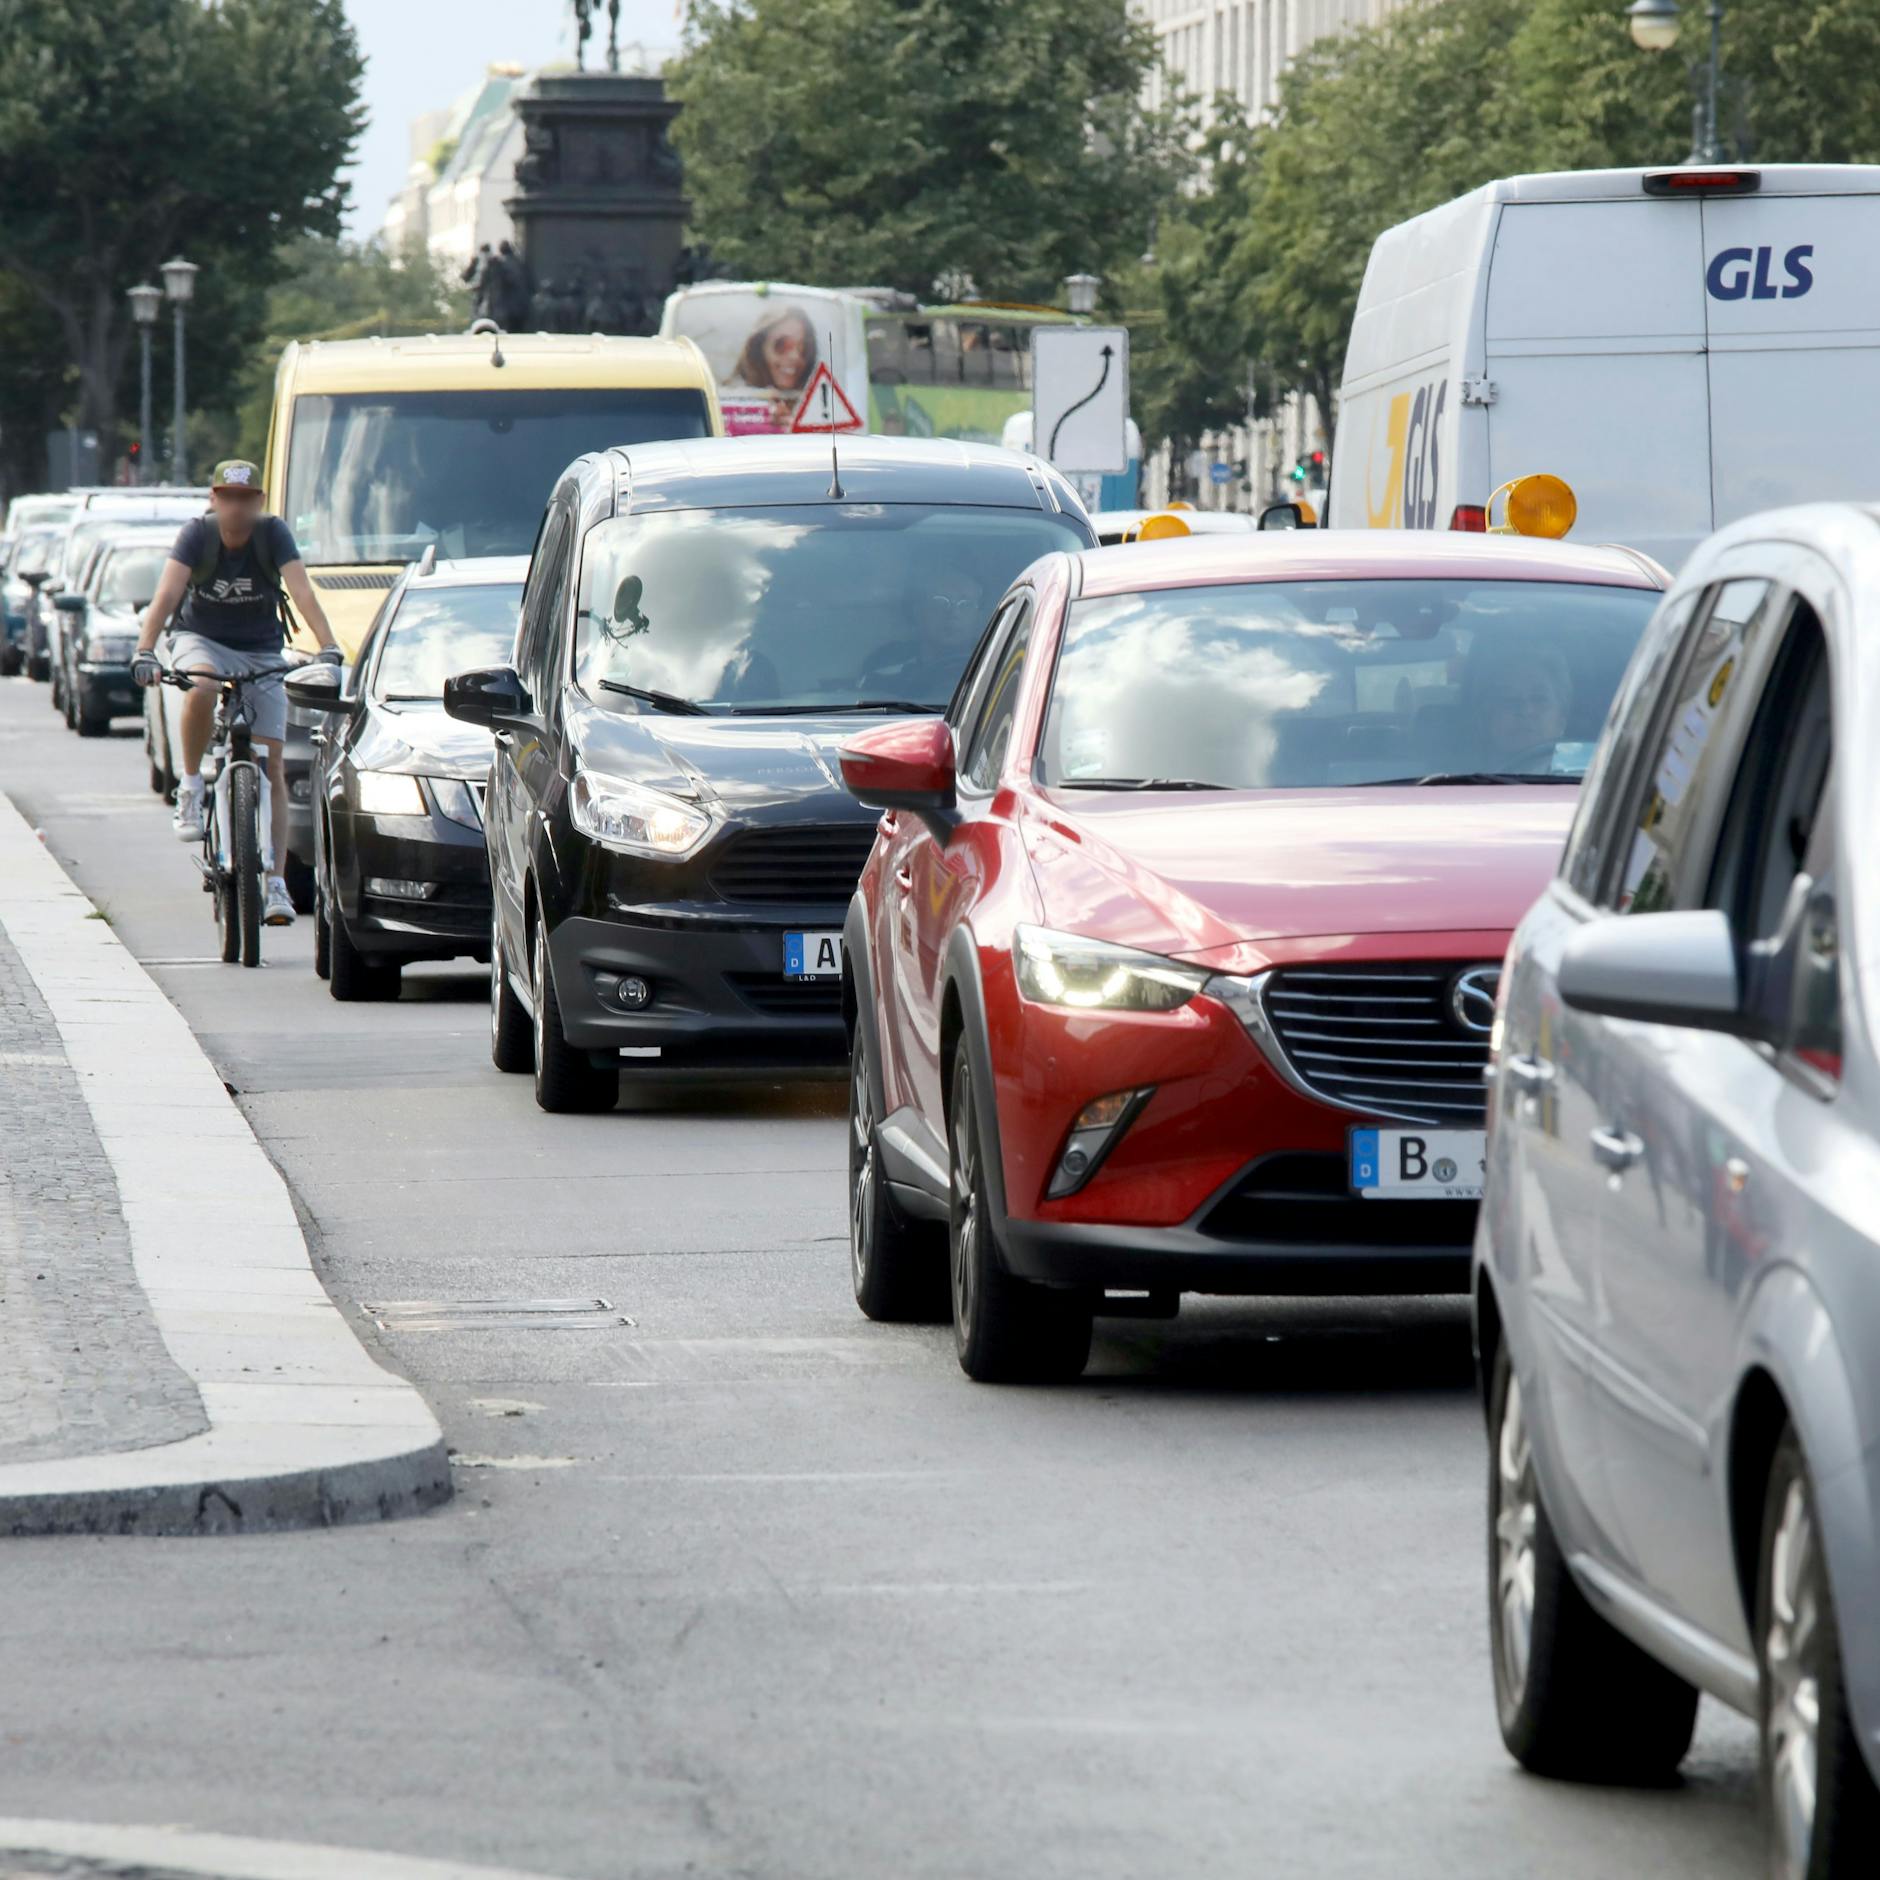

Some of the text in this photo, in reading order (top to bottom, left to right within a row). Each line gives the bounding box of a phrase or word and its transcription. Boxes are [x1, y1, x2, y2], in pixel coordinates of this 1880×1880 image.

[1707, 244, 1814, 301] GLS
[1404, 378, 1448, 529] GLS
[790, 938, 842, 968] D A
[1360, 1136, 1428, 1181] D B
